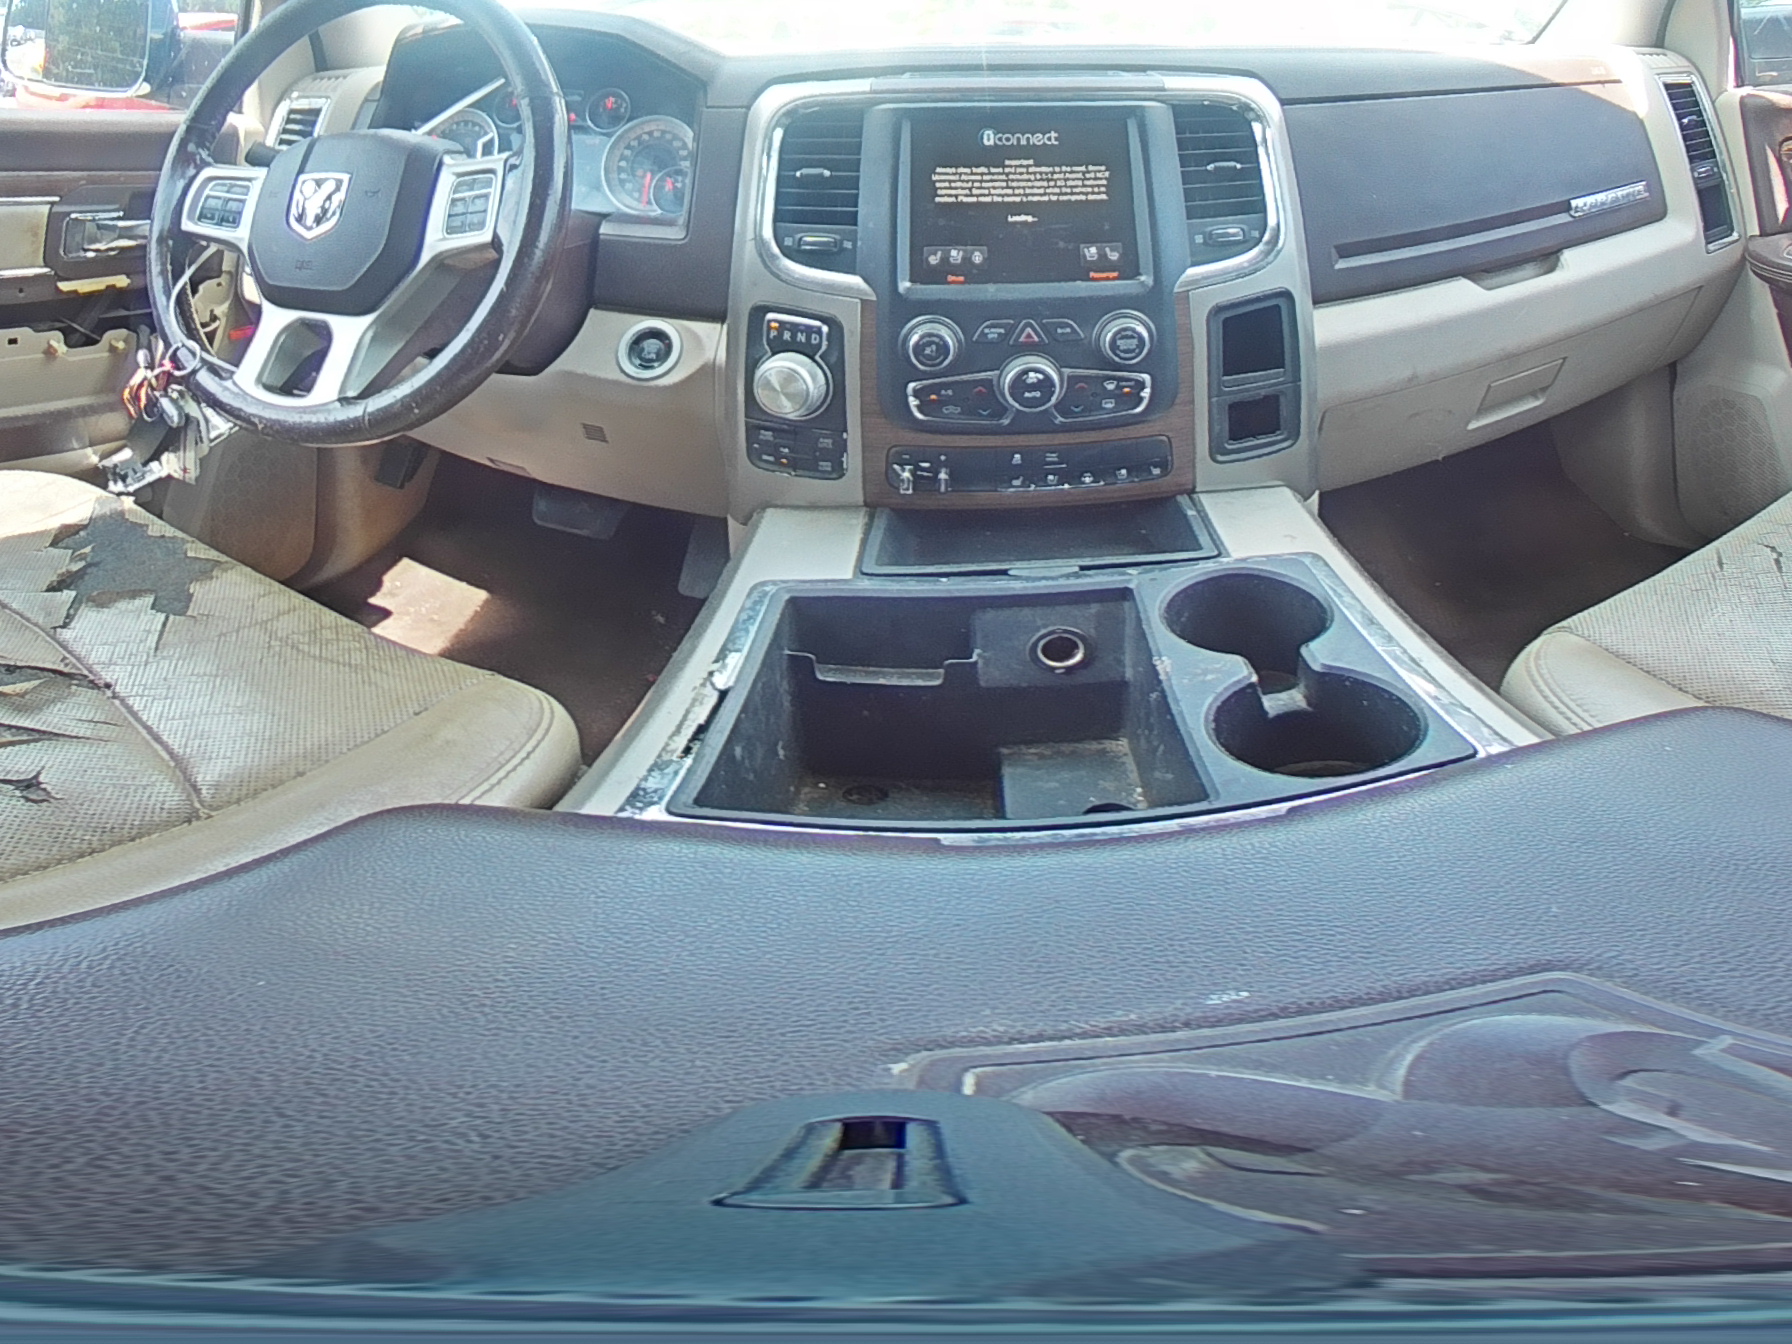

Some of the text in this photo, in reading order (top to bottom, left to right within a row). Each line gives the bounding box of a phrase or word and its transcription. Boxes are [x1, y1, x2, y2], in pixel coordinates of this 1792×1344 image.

[770, 330, 778, 340] P
[783, 331, 792, 341] R
[796, 332, 806, 343] N
[811, 333, 820, 344] D
